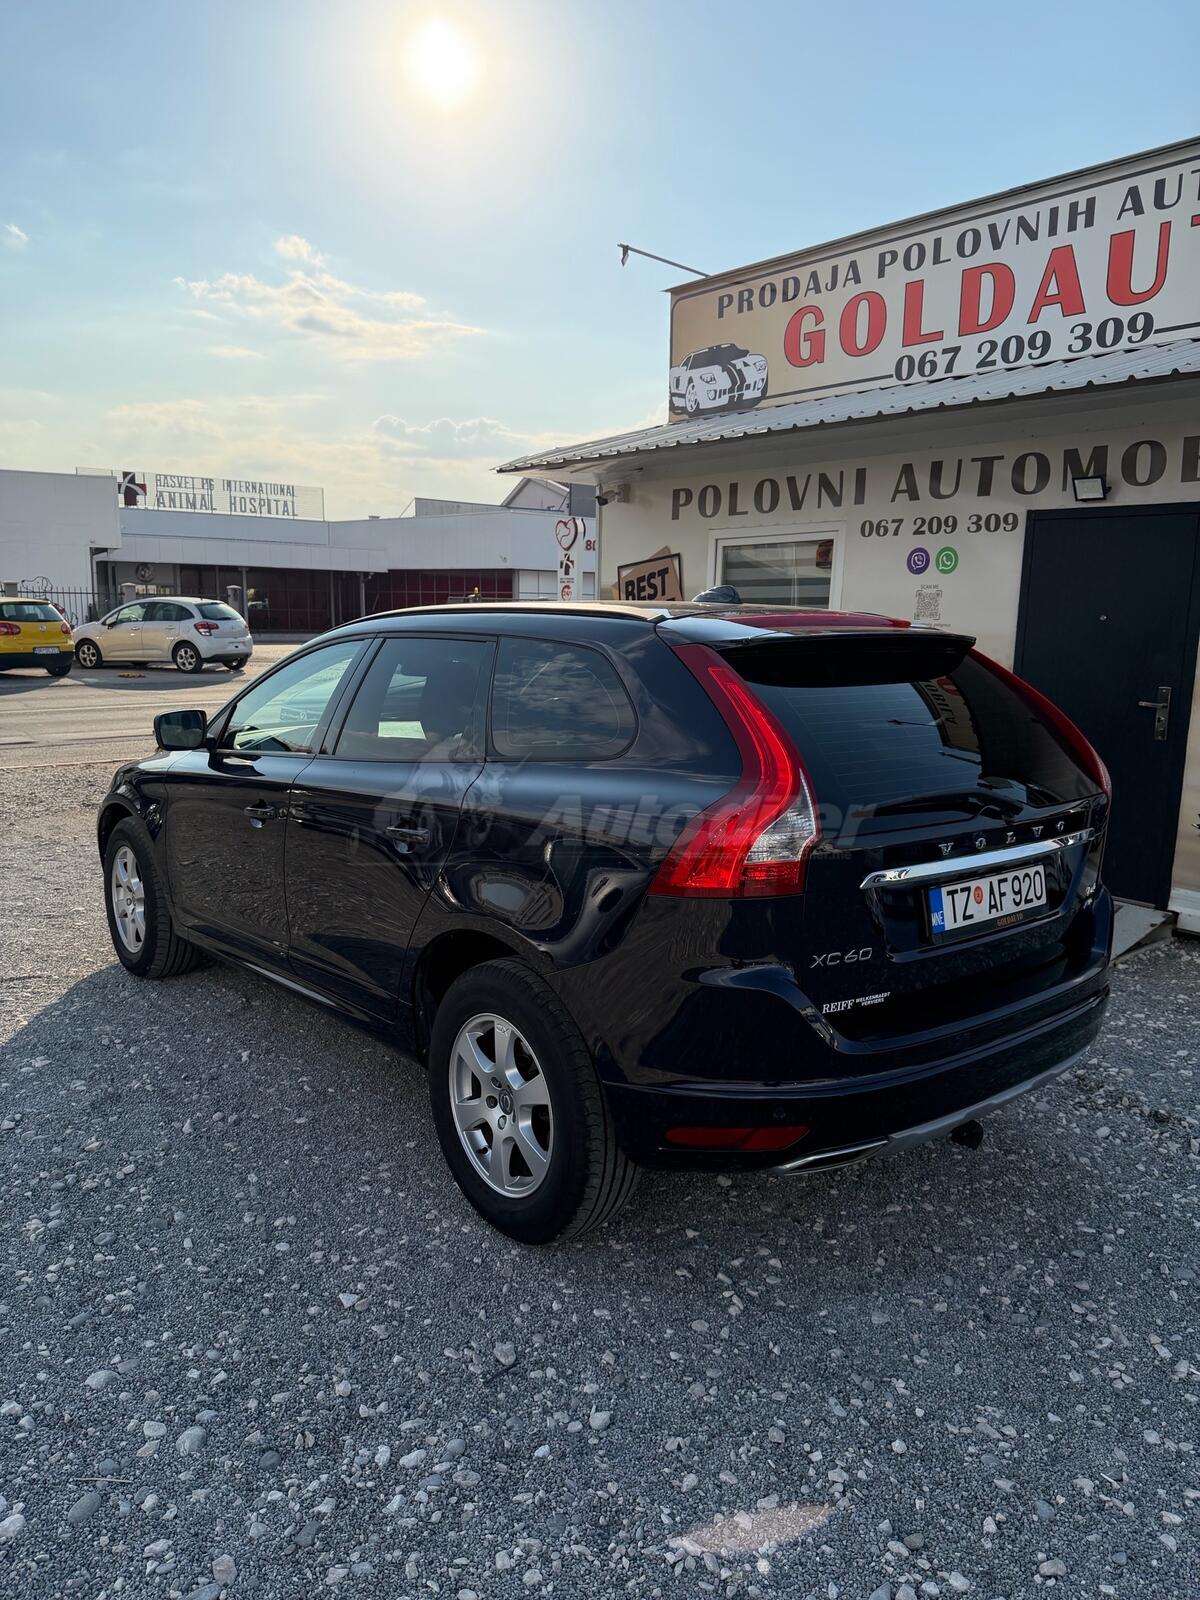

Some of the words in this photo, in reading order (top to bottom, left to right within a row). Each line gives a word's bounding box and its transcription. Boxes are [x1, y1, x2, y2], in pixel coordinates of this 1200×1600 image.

[717, 259, 862, 319] PRODAJA
[877, 196, 1097, 279] POLOVNIH
[783, 213, 1200, 368] GOLDAU
[893, 345, 961, 383] 067
[975, 330, 1052, 370] 209
[1067, 311, 1154, 354] 309
[157, 490, 217, 511] ANIMAL
[228, 495, 298, 516] HOSPITAL
[671, 467, 868, 520] POLOVNI
[860, 518, 904, 538] 067
[912, 515, 958, 536] 209
[967, 512, 1019, 534] 309
[625, 567, 670, 601] BEST
[938, 820, 1066, 856] VOLVO
[946, 885, 975, 924] TZ
[988, 869, 1045, 914] AF920
[821, 999, 855, 1014] REIFF
